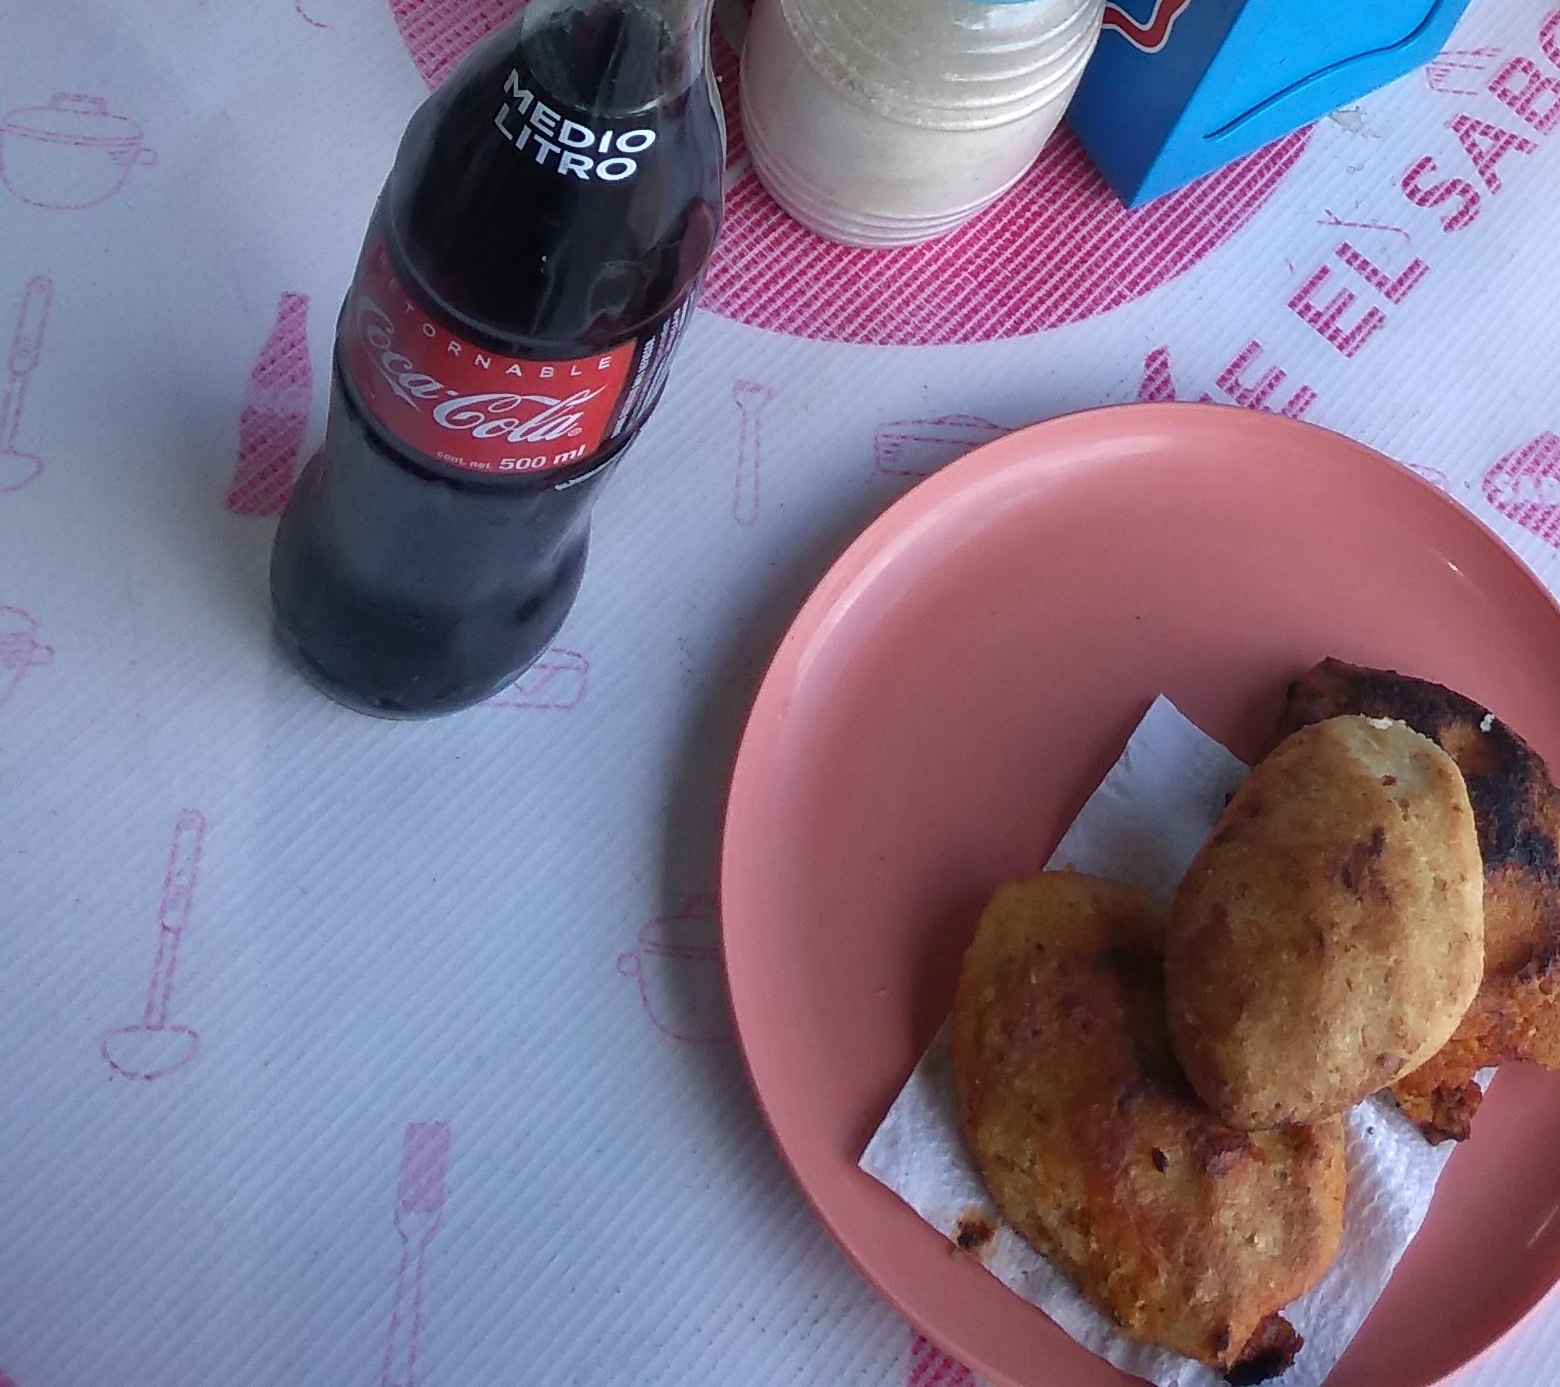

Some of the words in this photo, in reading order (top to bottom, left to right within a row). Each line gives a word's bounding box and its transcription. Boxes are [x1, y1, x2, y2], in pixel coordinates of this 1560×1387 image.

[494, 101, 638, 182] LITRO
[503, 67, 657, 154] MEDIO
[1286, 240, 1431, 360] EL
[357, 296, 608, 444] Coca-Cola
[498, 456, 547, 471] 500
[553, 444, 586, 465] ml
